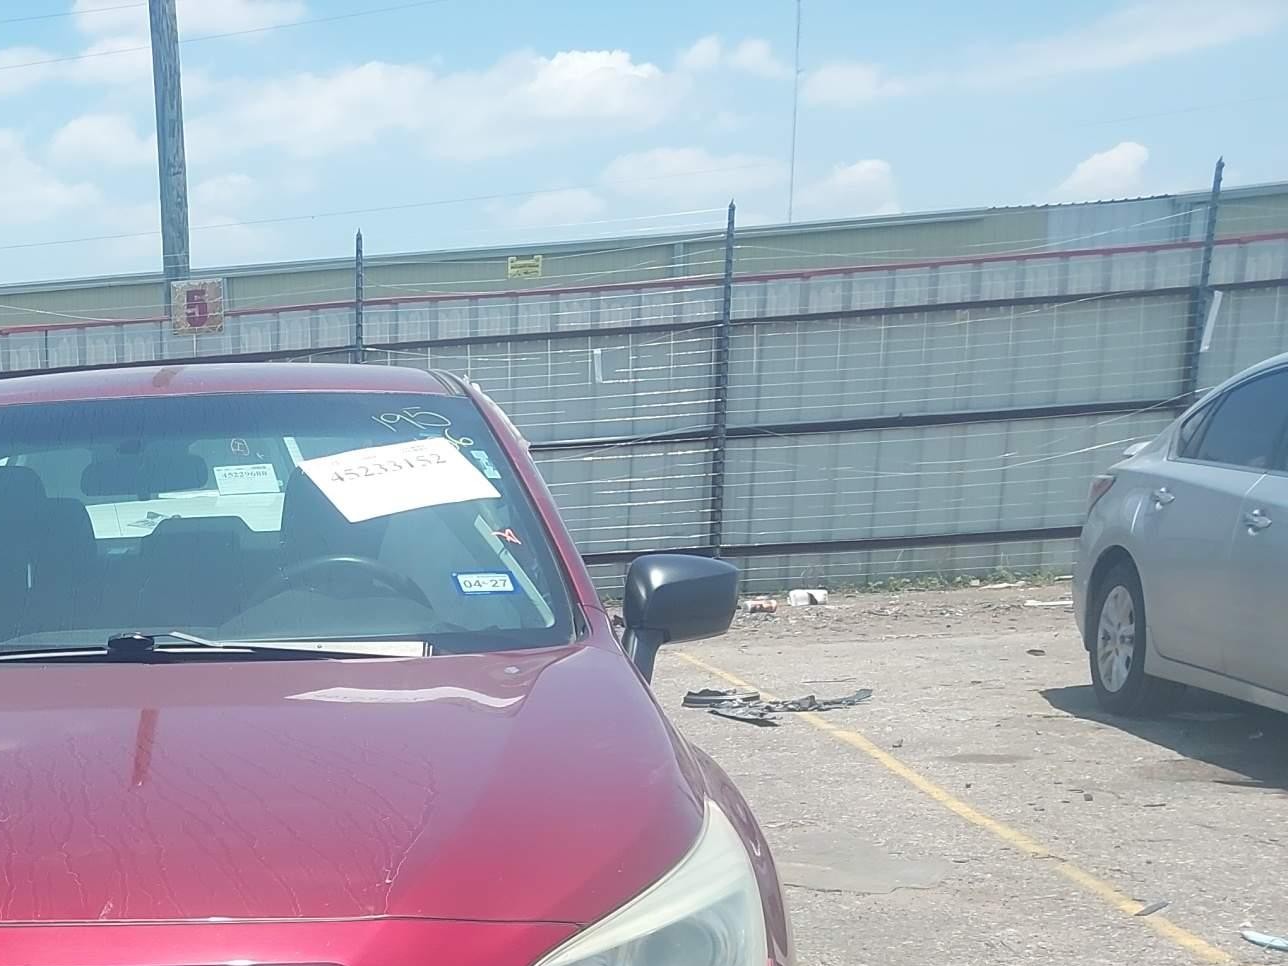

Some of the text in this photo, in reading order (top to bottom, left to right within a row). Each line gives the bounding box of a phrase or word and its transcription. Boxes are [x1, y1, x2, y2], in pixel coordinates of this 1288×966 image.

[185, 288, 208, 328] 5
[330, 453, 448, 482] 45233152
[462, 578, 508, 589] 04-27
